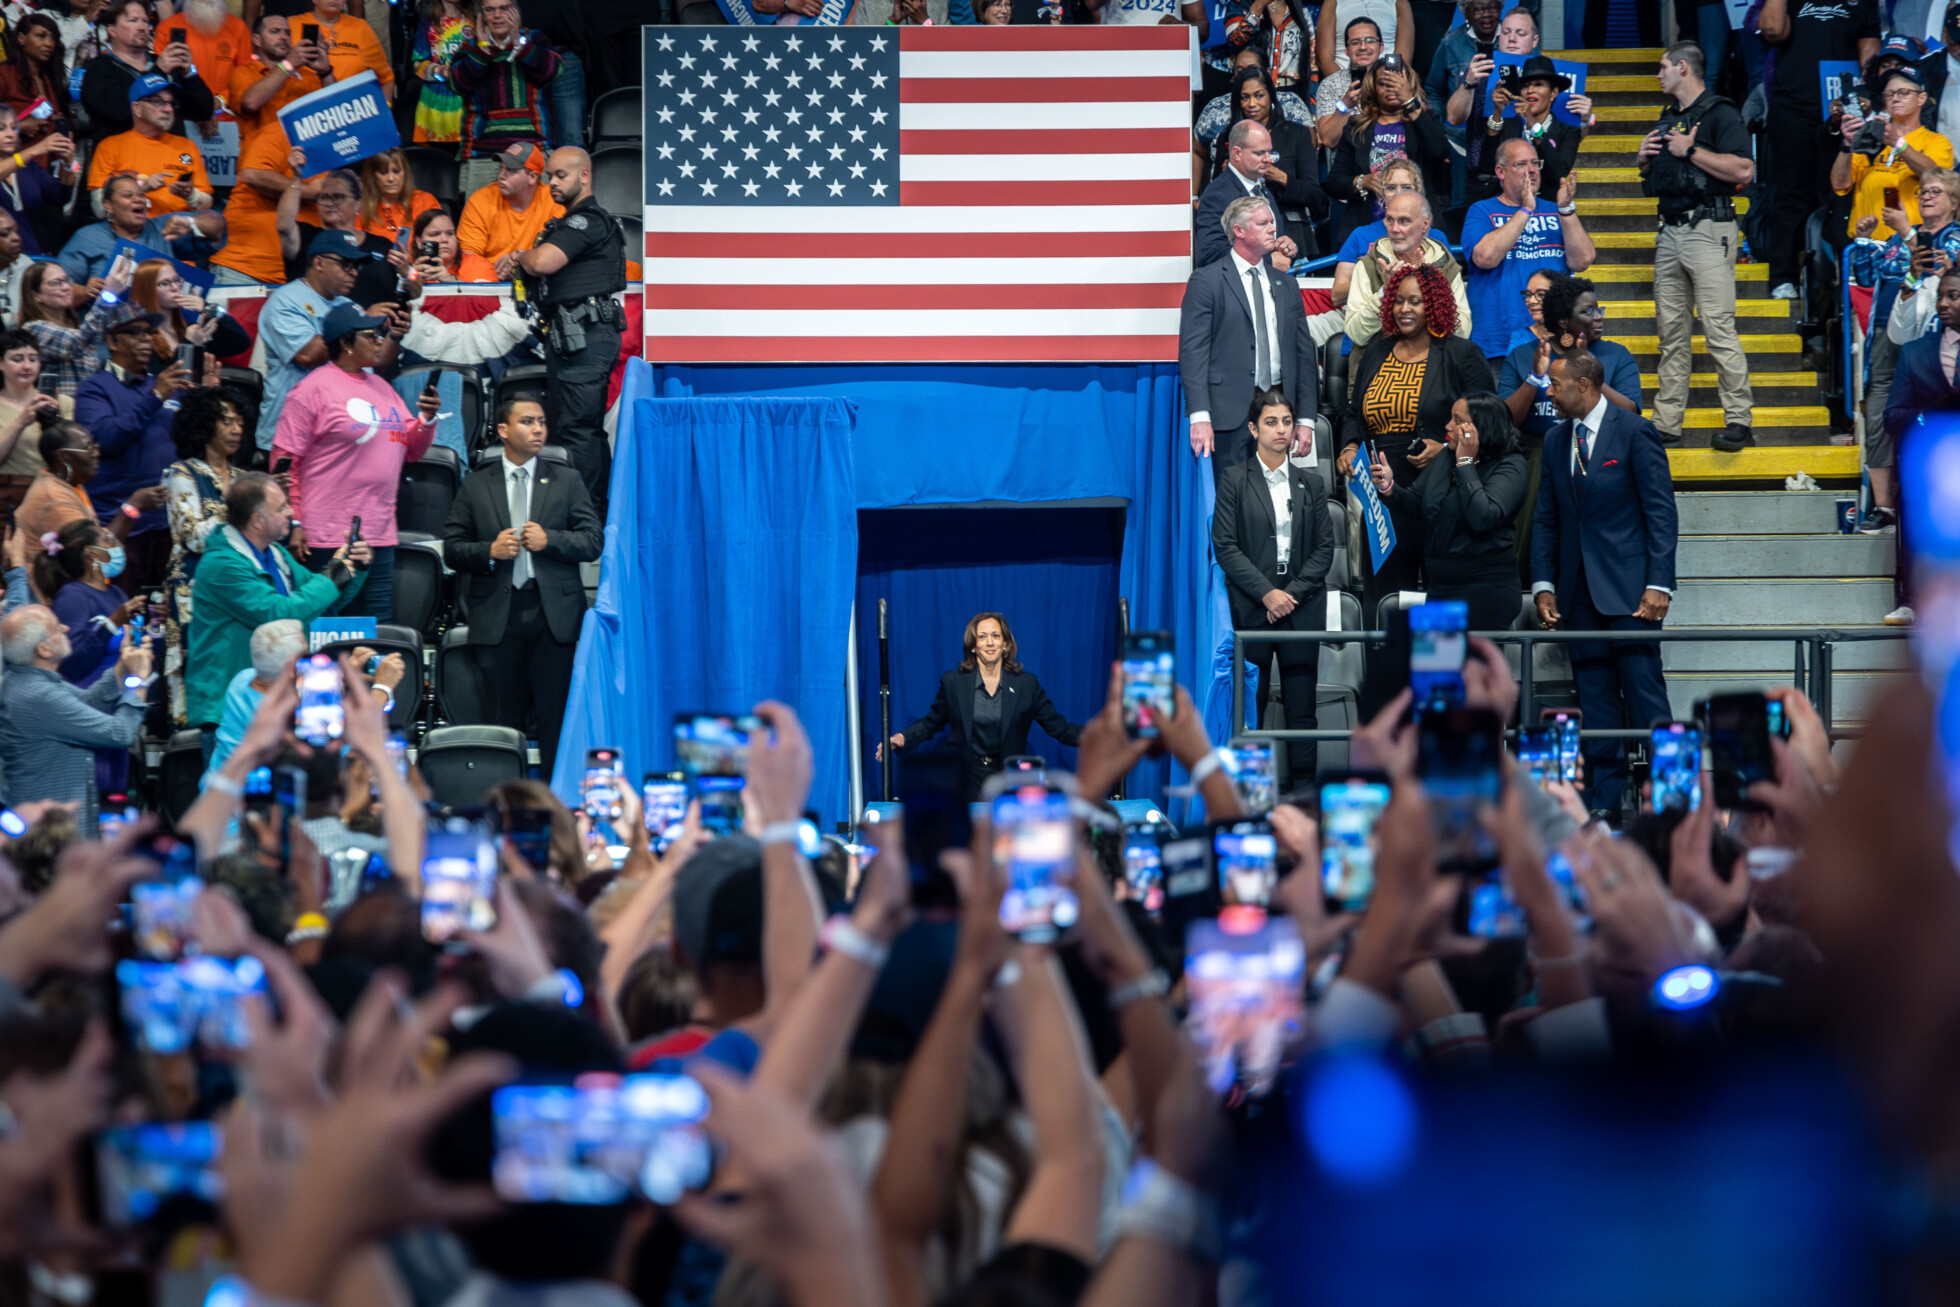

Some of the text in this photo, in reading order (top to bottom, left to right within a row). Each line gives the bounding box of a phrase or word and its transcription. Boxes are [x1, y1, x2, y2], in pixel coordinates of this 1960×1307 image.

[1121, 0, 1176, 13] 2024
[293, 94, 379, 141] MICHIGAN
[1354, 458, 1391, 555] FREEDOM
